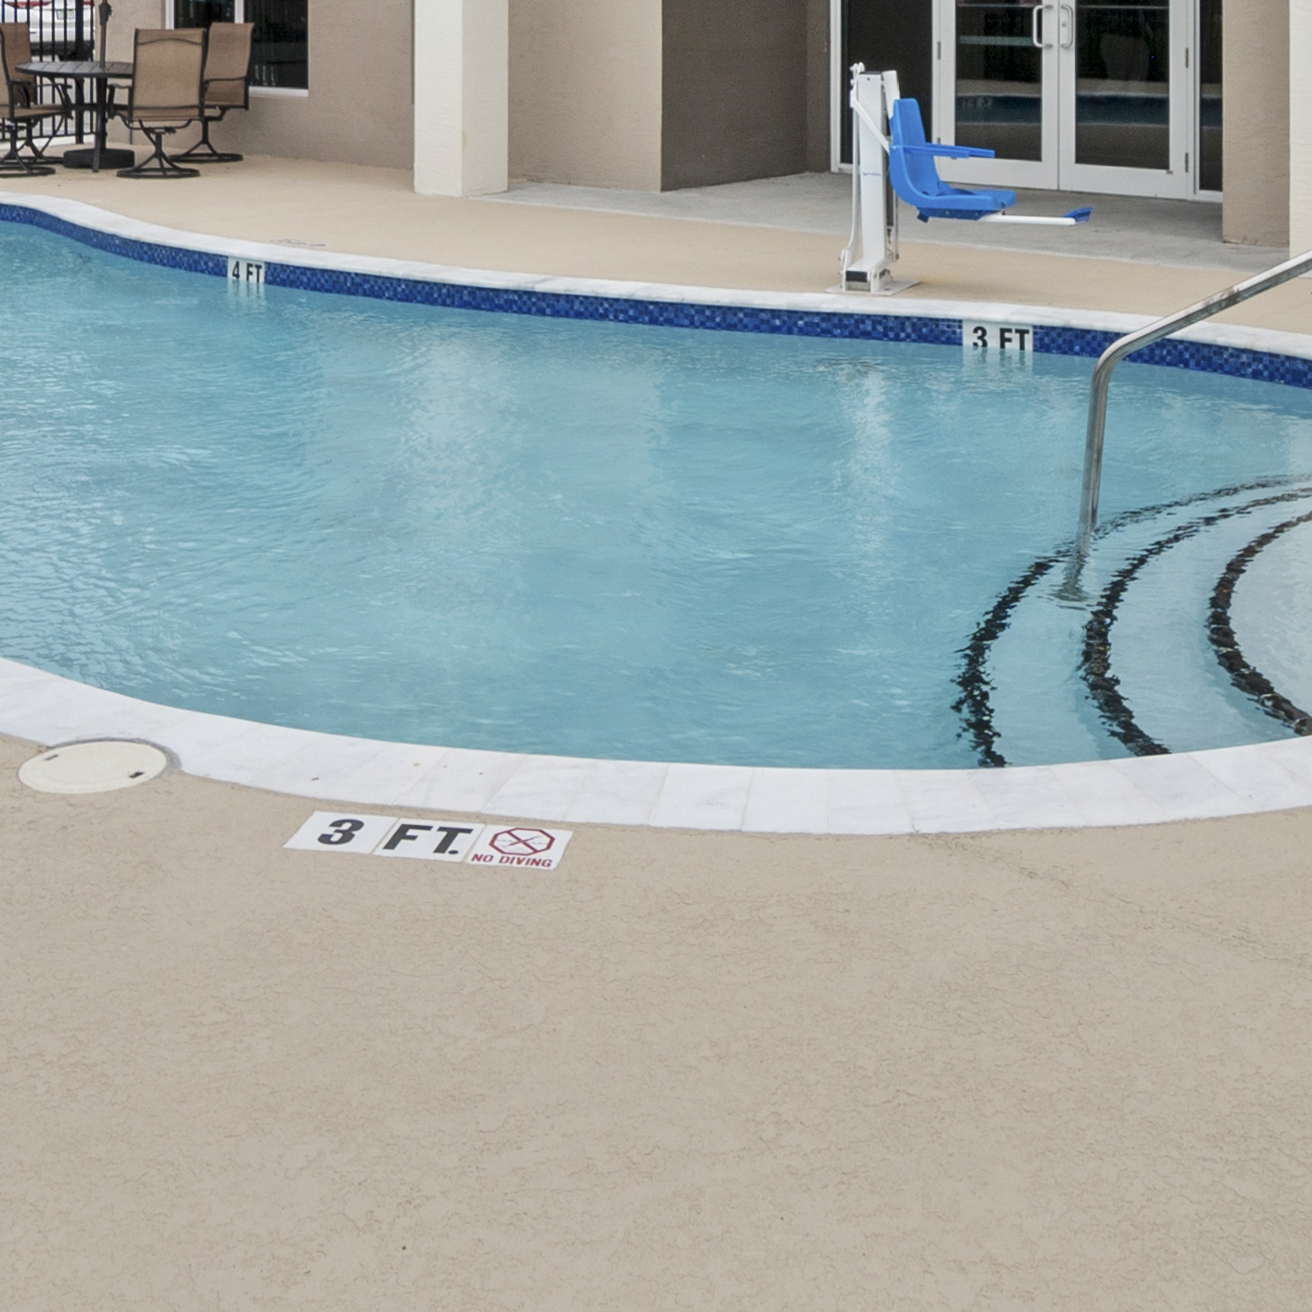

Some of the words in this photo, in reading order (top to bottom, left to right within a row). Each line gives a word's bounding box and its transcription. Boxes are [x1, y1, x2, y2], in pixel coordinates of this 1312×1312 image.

[232, 261, 240, 279] 4
[246, 263, 262, 283] FT
[972, 326, 988, 347] 3
[999, 328, 1030, 350] FT
[317, 819, 365, 845] 3
[471, 854, 494, 862] NO
[499, 856, 552, 868] DIVING
